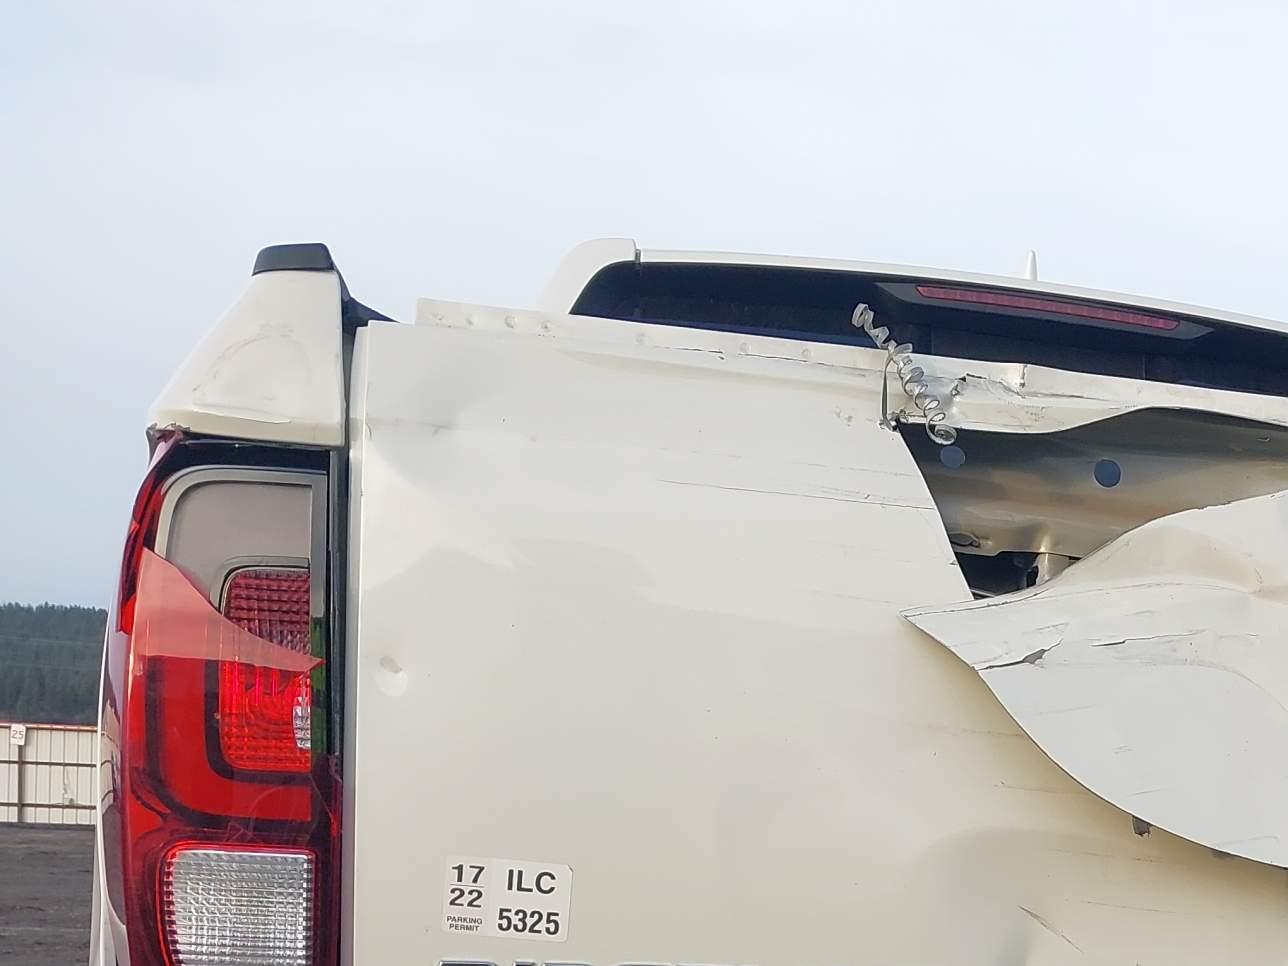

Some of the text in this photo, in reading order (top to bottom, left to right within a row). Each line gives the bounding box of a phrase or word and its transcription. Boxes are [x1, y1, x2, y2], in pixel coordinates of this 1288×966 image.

[451, 863, 486, 884] 17
[506, 868, 557, 895] ILC
[448, 887, 484, 908] 22
[446, 915, 483, 925] PARKING
[448, 923, 481, 932] PERMIT
[497, 907, 560, 936] 5325
